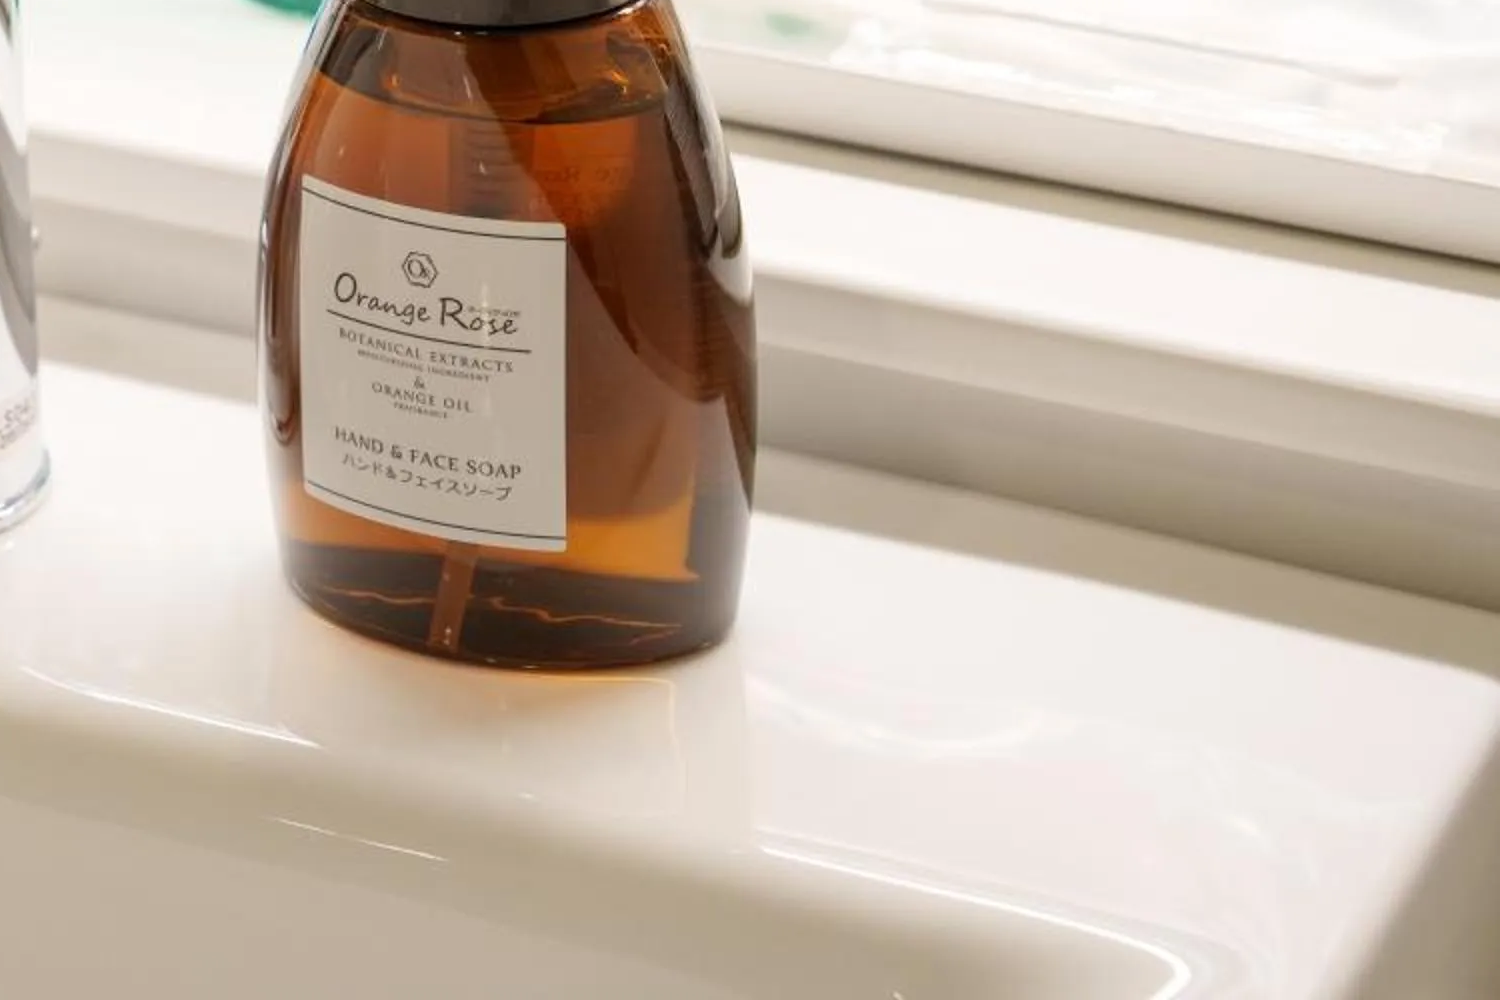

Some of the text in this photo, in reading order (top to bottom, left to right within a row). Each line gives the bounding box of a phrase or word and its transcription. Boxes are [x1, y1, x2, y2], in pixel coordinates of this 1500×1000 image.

[332, 271, 519, 336] Orange Rose
[338, 327, 514, 374] BOTANICAL EXTRACTS
[370, 380, 475, 414] ORANGE OIL
[413, 376, 426, 390] &
[334, 424, 522, 480] HAND & FACE SOAP
